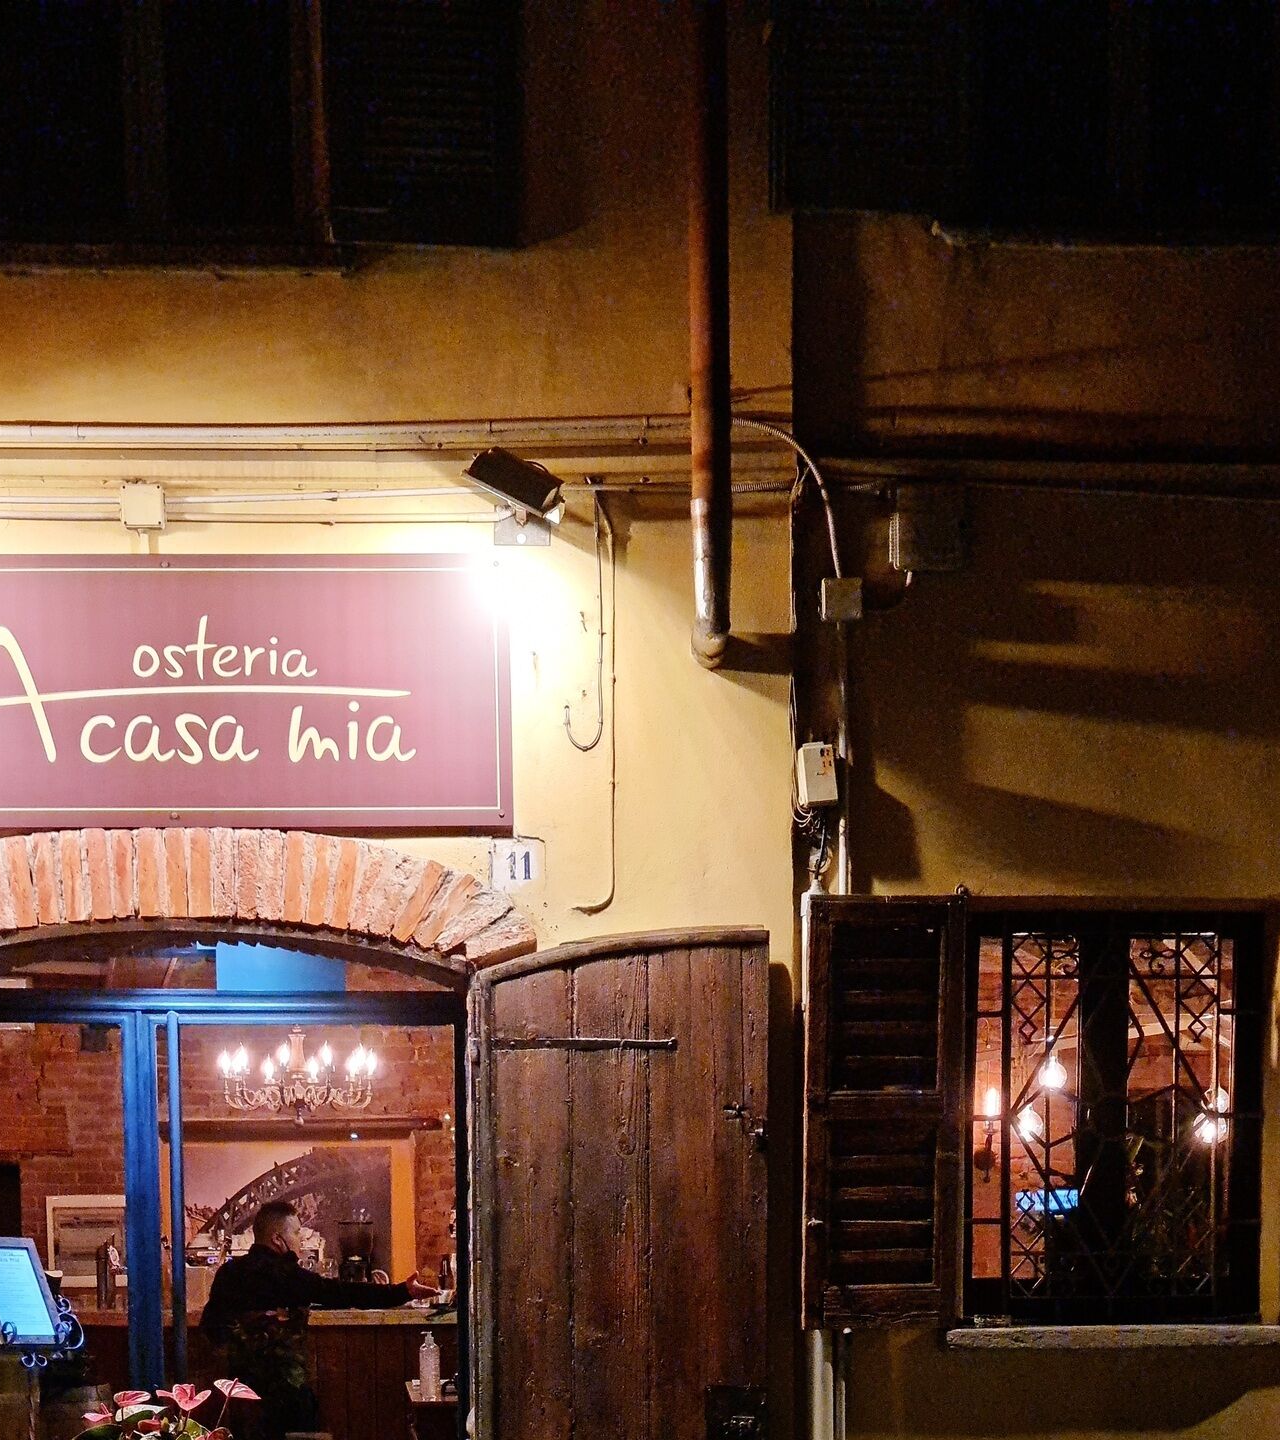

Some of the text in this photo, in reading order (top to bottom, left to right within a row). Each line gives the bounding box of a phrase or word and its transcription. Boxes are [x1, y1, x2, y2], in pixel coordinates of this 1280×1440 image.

[132, 615, 319, 679] osteria
[79, 712, 260, 764] casa
[288, 700, 417, 764] mia
[506, 851, 532, 880] 11
